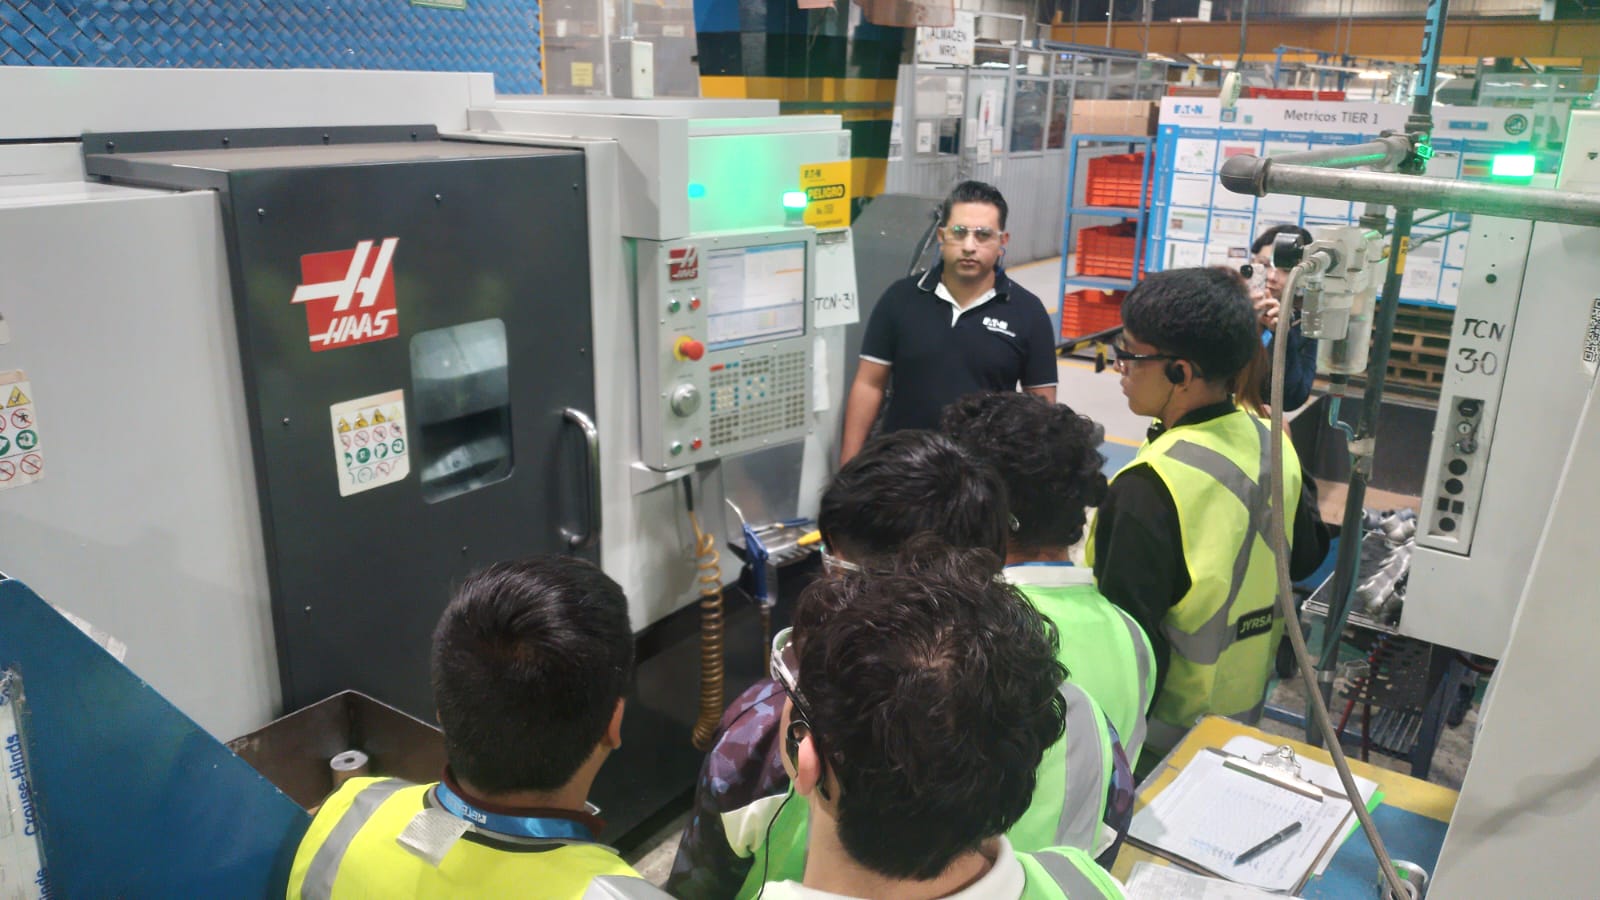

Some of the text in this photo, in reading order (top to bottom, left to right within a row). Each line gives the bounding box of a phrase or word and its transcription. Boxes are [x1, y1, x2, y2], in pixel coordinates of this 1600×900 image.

[1284, 108, 1379, 125] Metricos TIER 1
[309, 308, 397, 346] HAAS
[1462, 318, 1506, 341] TCN
[1455, 347, 1498, 376] 30
[1239, 613, 1272, 634] JYRSA
[5, 733, 38, 837] Crouse-Hinds
